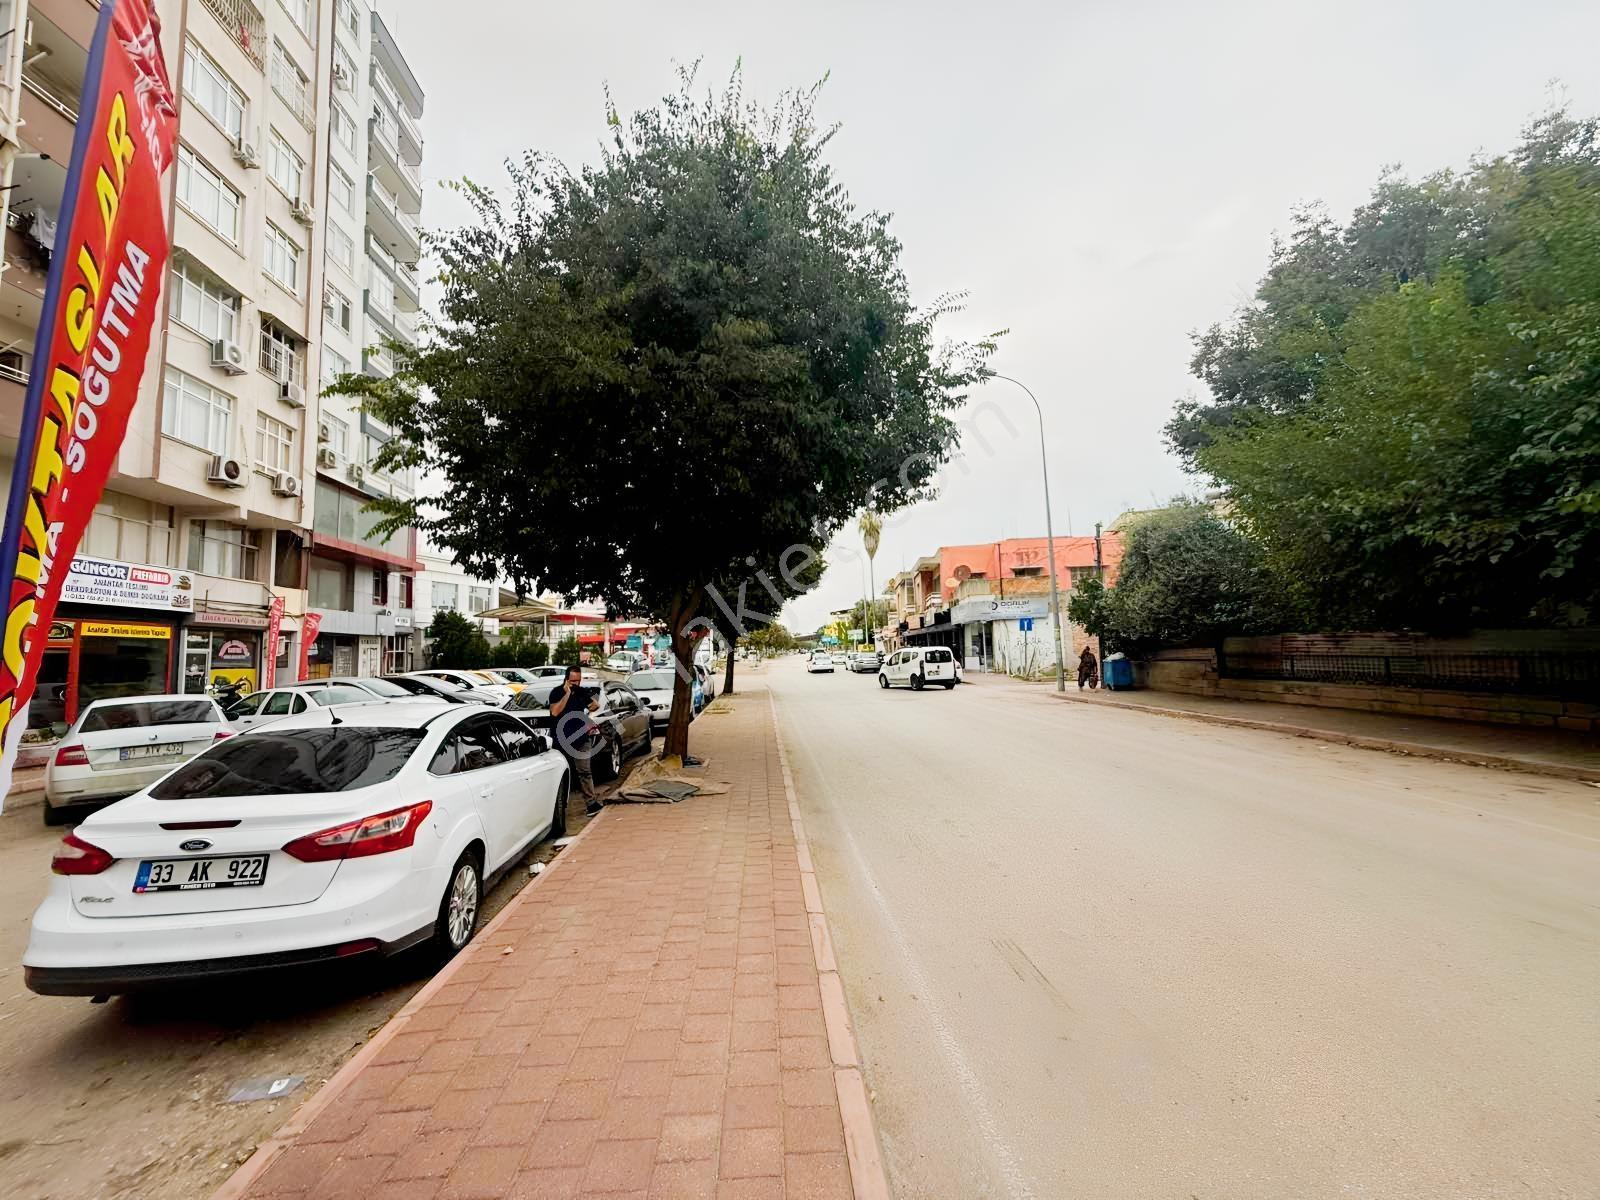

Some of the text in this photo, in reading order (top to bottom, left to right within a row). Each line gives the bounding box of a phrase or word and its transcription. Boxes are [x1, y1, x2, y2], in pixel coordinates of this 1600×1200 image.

[70, 561, 127, 580] GÜNGÖR
[184, 840, 207, 850] Ford
[150, 864, 174, 883] 33
[188, 861, 212, 882] AK
[227, 859, 263, 880] 922
